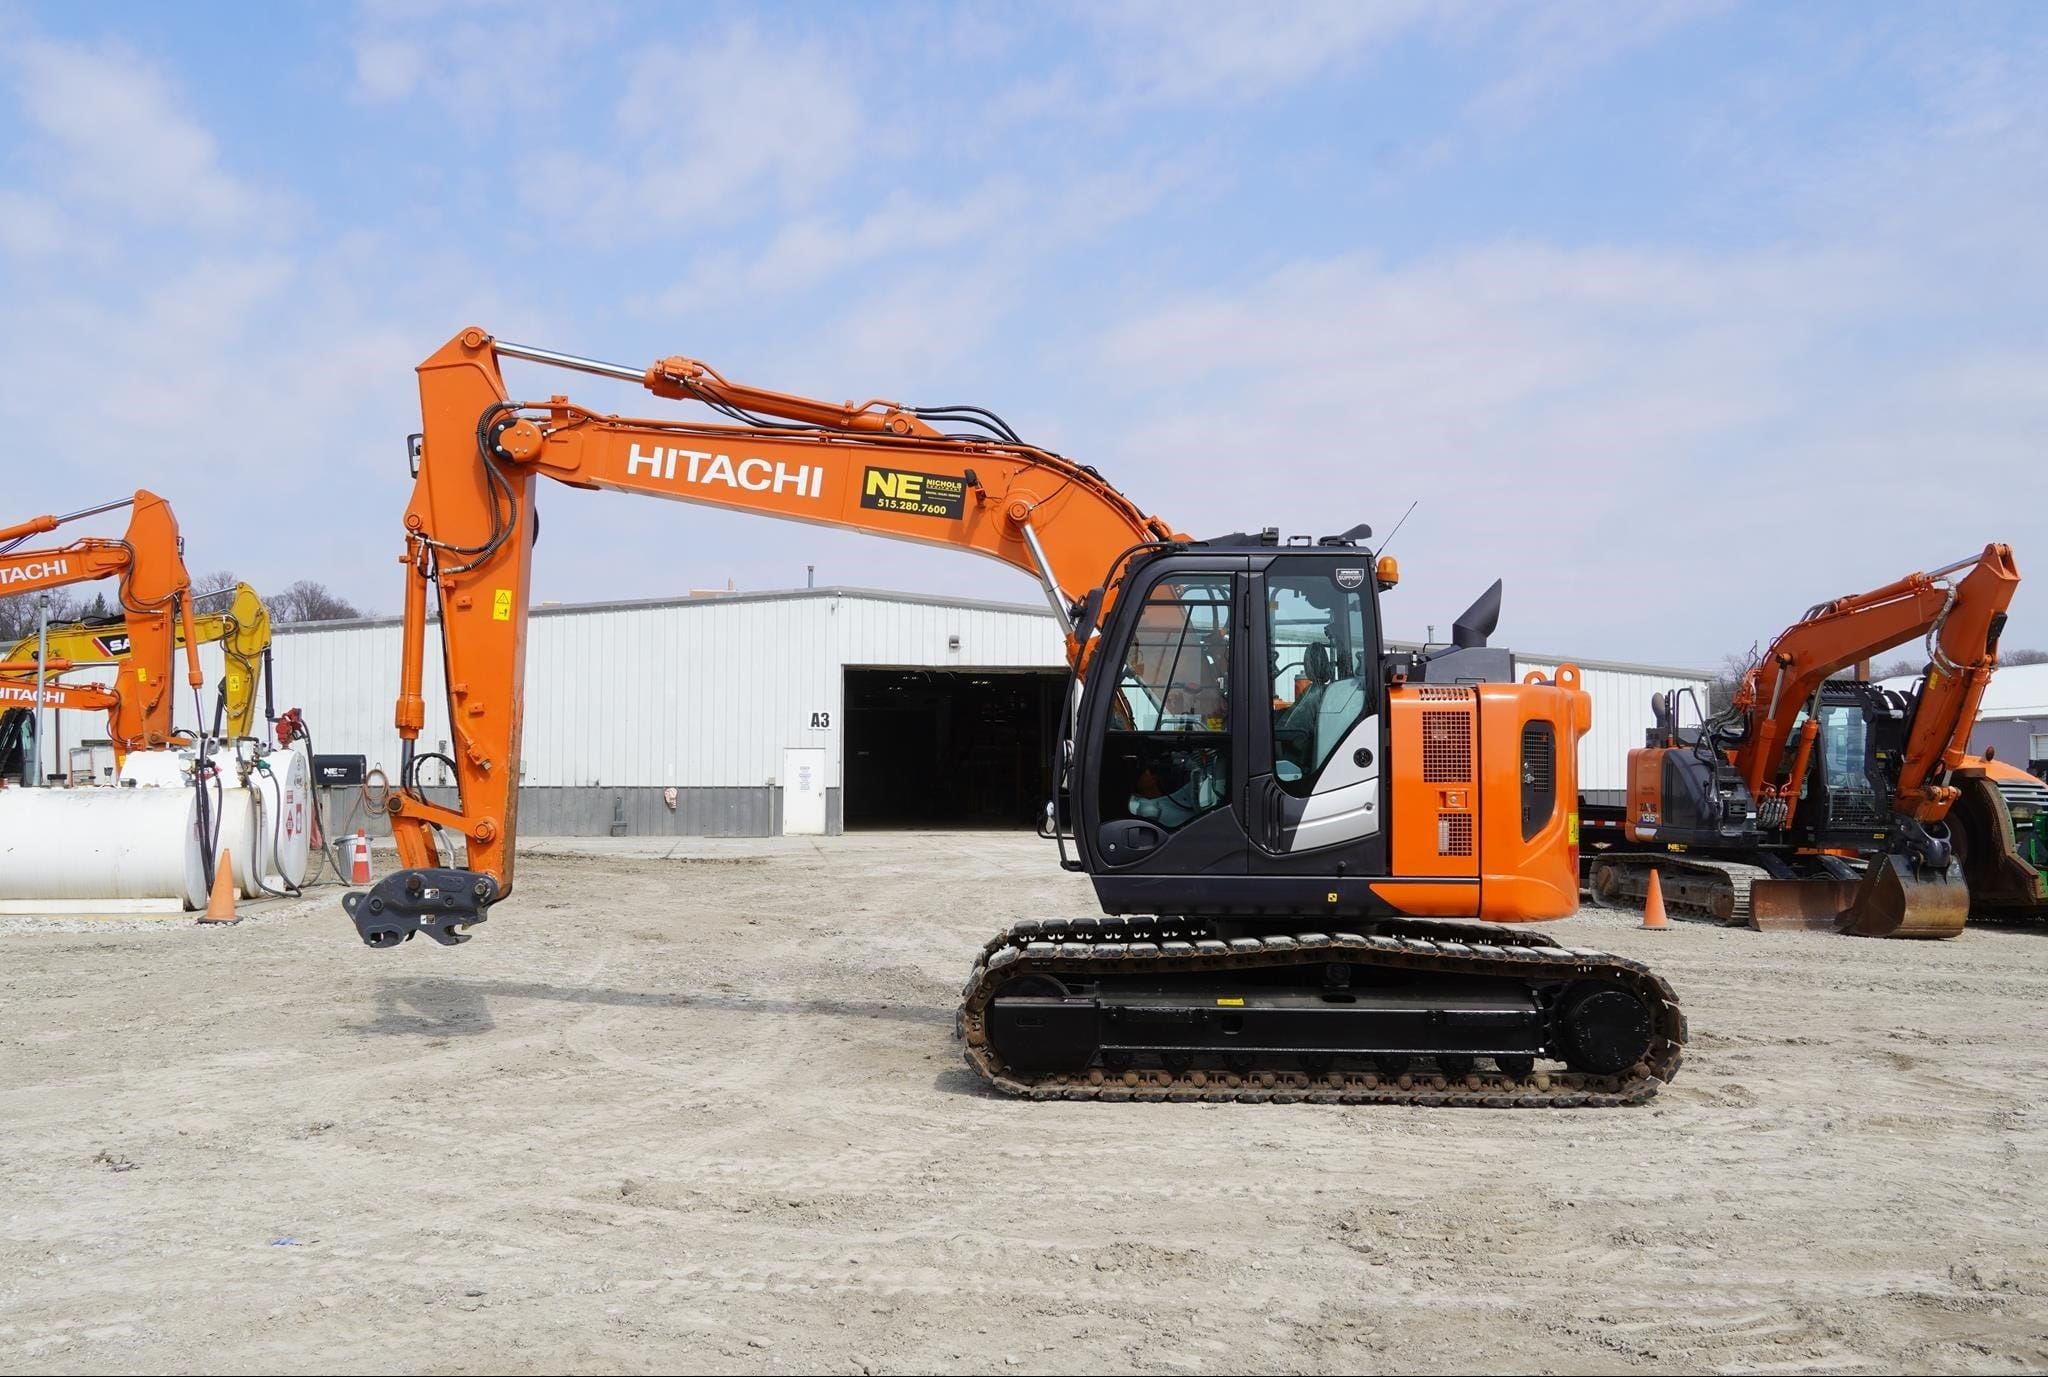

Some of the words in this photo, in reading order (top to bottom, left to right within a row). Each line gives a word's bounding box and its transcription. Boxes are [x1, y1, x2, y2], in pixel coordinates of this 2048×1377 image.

[627, 443, 824, 498] HITACHI
[866, 470, 923, 501] NE
[925, 479, 962, 489] NICHOLS
[877, 499, 947, 515] 515.280.7600
[810, 712, 830, 728] A3
[1642, 812, 1656, 823] 135
